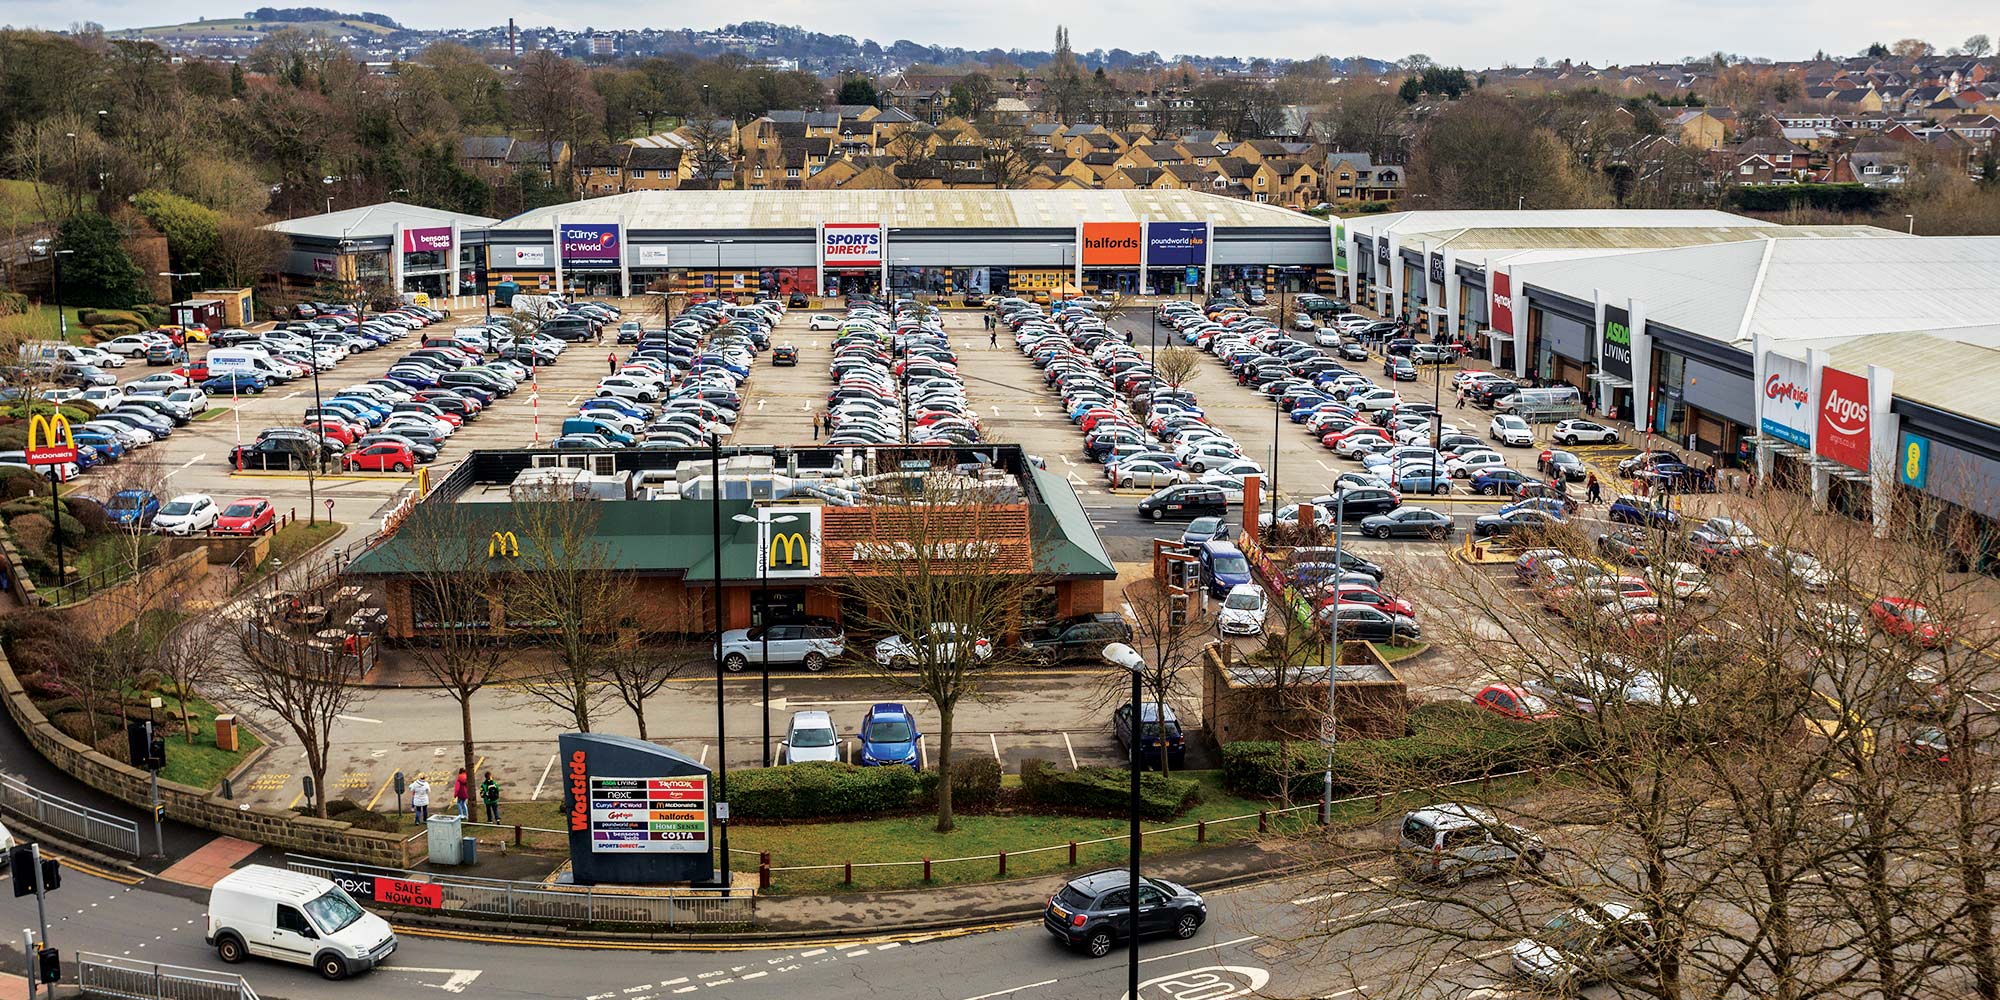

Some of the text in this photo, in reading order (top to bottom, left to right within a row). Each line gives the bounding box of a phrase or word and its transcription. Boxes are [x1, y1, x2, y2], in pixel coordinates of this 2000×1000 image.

[567, 229, 599, 241] Currys
[826, 234, 878, 245] SPORTS
[565, 243, 601, 251] PC World
[1085, 237, 1139, 249] halfords
[1151, 238, 1189, 246] poundworld
[1606, 321, 1630, 346] ASDA
[1604, 342, 1630, 364] LIVING
[1825, 389, 1868, 423] Argos
[32, 452, 73, 460] McDonald's
[433, 748, 448, 756] 3
[334, 878, 372, 894] next
[394, 882, 422, 894] SALE
[386, 892, 432, 906] NOW ON
